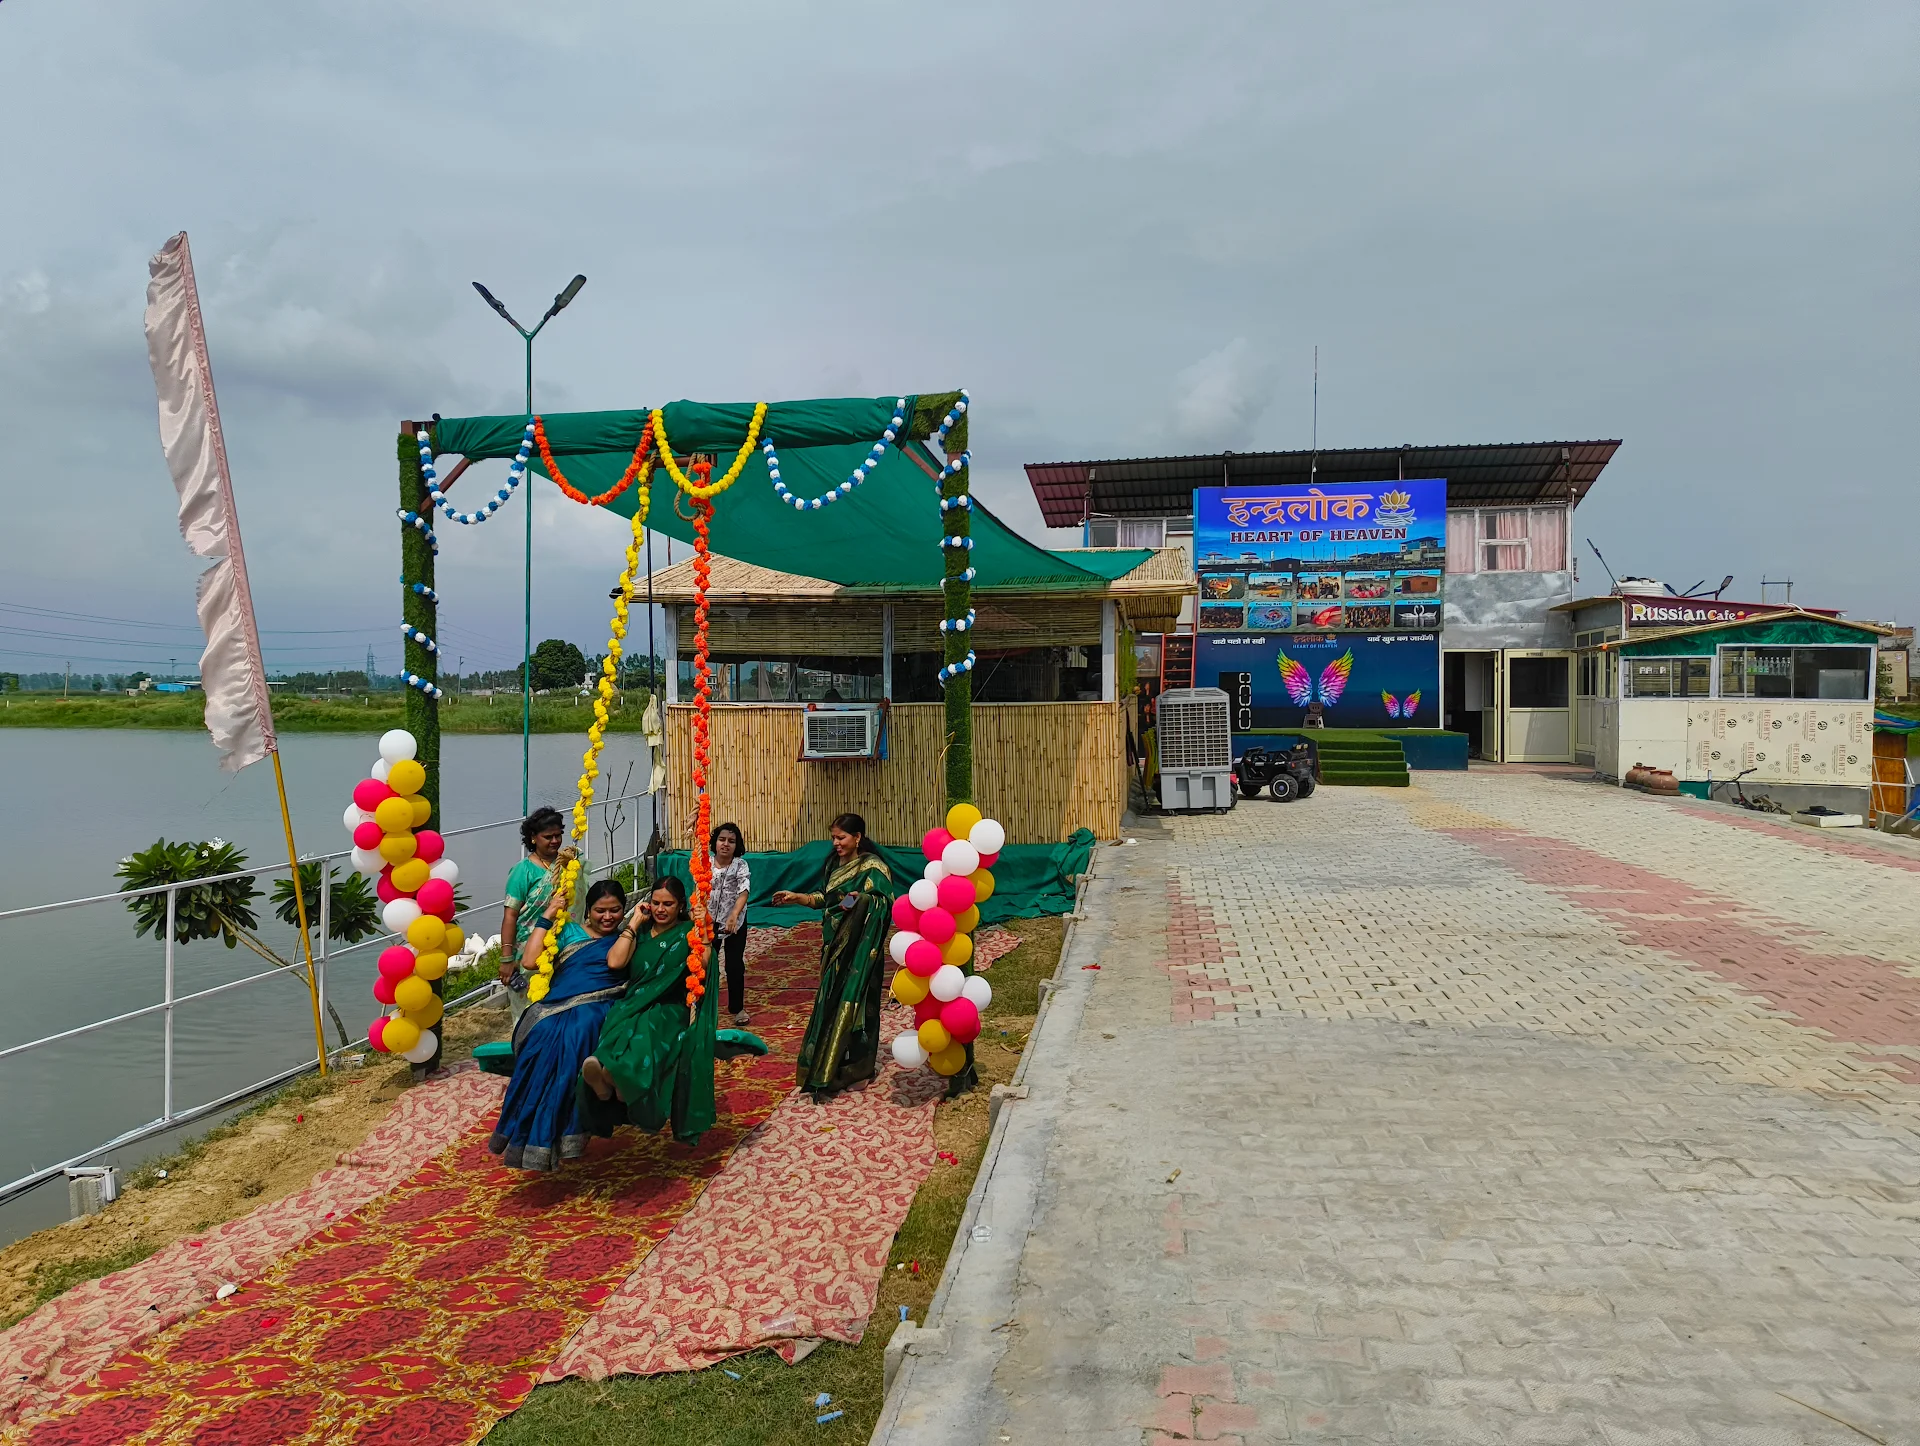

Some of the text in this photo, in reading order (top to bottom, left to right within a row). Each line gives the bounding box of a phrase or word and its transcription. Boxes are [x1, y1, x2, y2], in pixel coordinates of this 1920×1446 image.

[1221, 488, 1374, 527] इन्द्रलोक
[1230, 527, 1407, 543] HEART OF HEAVEN
[1631, 603, 1736, 621] Russian Cafe
[1718, 708, 1727, 740] HEIGHTS
[1762, 709, 1771, 741] HEIGHTS
[1808, 710, 1817, 742] HEIGHTS
[1855, 711, 1864, 743] HEIGHTS
[1747, 741, 1755, 770] HEIGHT
[1792, 743, 1800, 775] HEIGHTS
[1838, 744, 1847, 777] HEIGHTS
